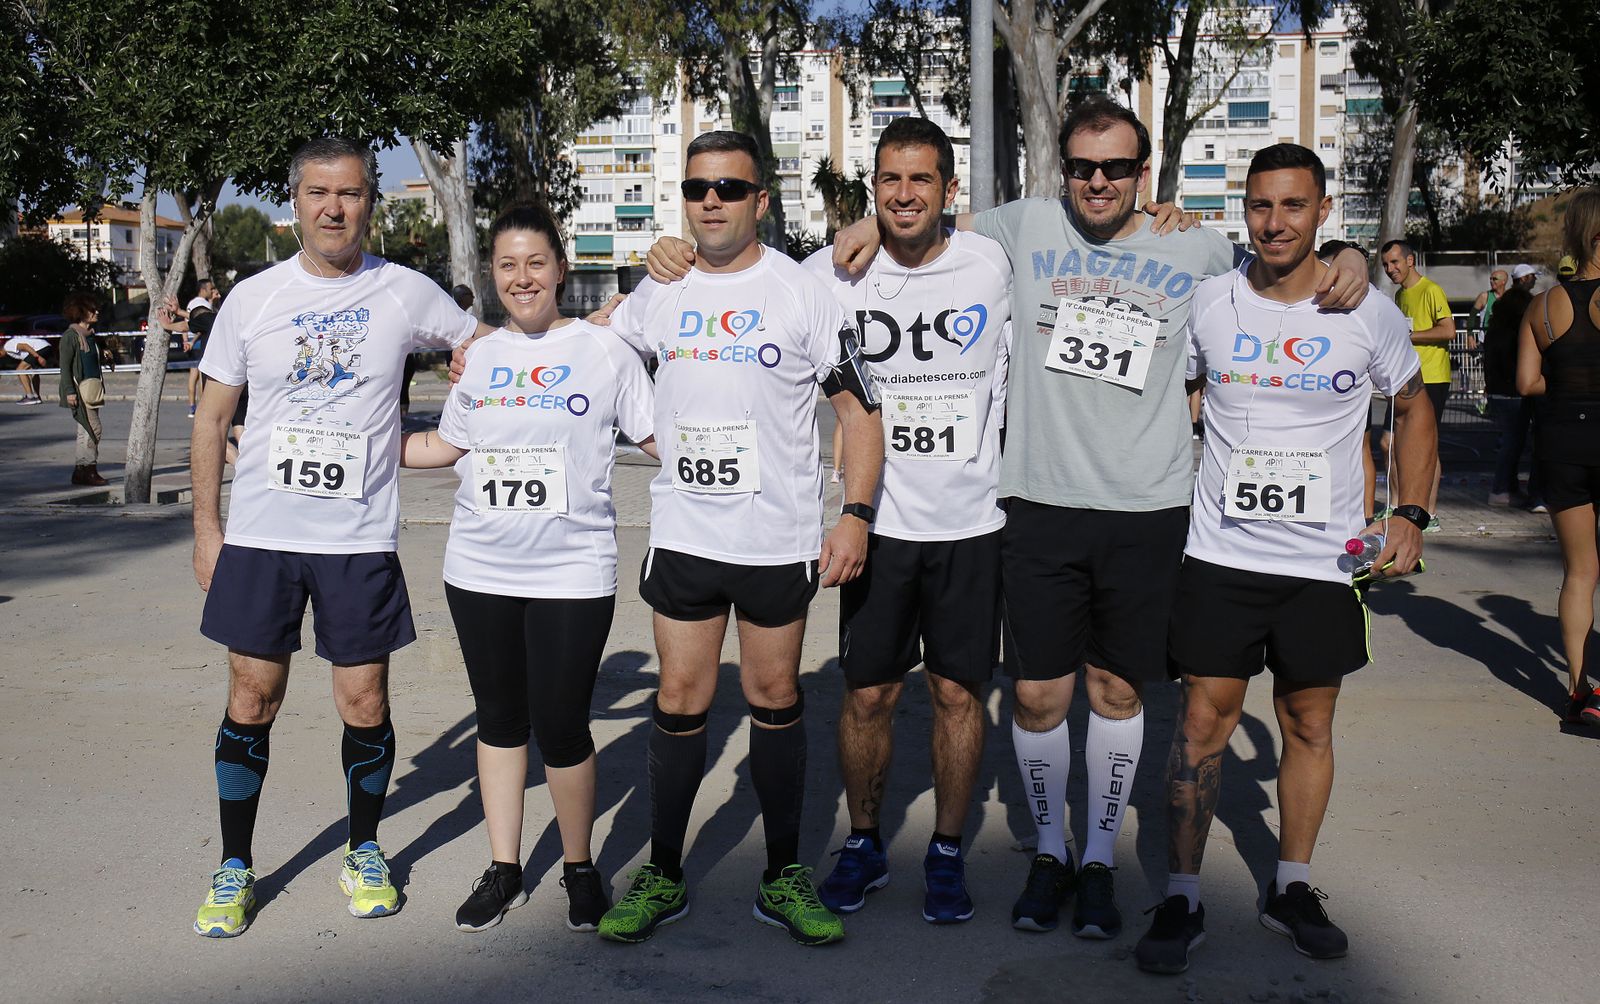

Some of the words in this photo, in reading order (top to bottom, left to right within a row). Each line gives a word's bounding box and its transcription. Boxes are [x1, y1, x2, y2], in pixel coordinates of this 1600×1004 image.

[1031, 248, 1194, 299] NAGANO
[1051, 277, 1168, 311] 自動車レース
[1073, 304, 1105, 316] CARRERA
[1106, 310, 1115, 318] DE
[1116, 313, 1125, 321] LA
[1127, 316, 1153, 327] PRENSA
[1058, 336, 1133, 377] 331
[283, 426, 315, 435] CARRERA
[336, 432, 361, 440] PRENSA
[722, 424, 749, 432] PRENSA
[891, 425, 955, 454] 581
[1241, 449, 1273, 457] CARRERA
[1265, 458, 1283, 467] APM
[276, 458, 345, 491] 159
[677, 456, 740, 486] 685
[482, 479, 547, 507] 179
[1234, 482, 1306, 514] 561
[1023, 758, 1052, 826] kalenji
[1098, 751, 1134, 832] kalenji
